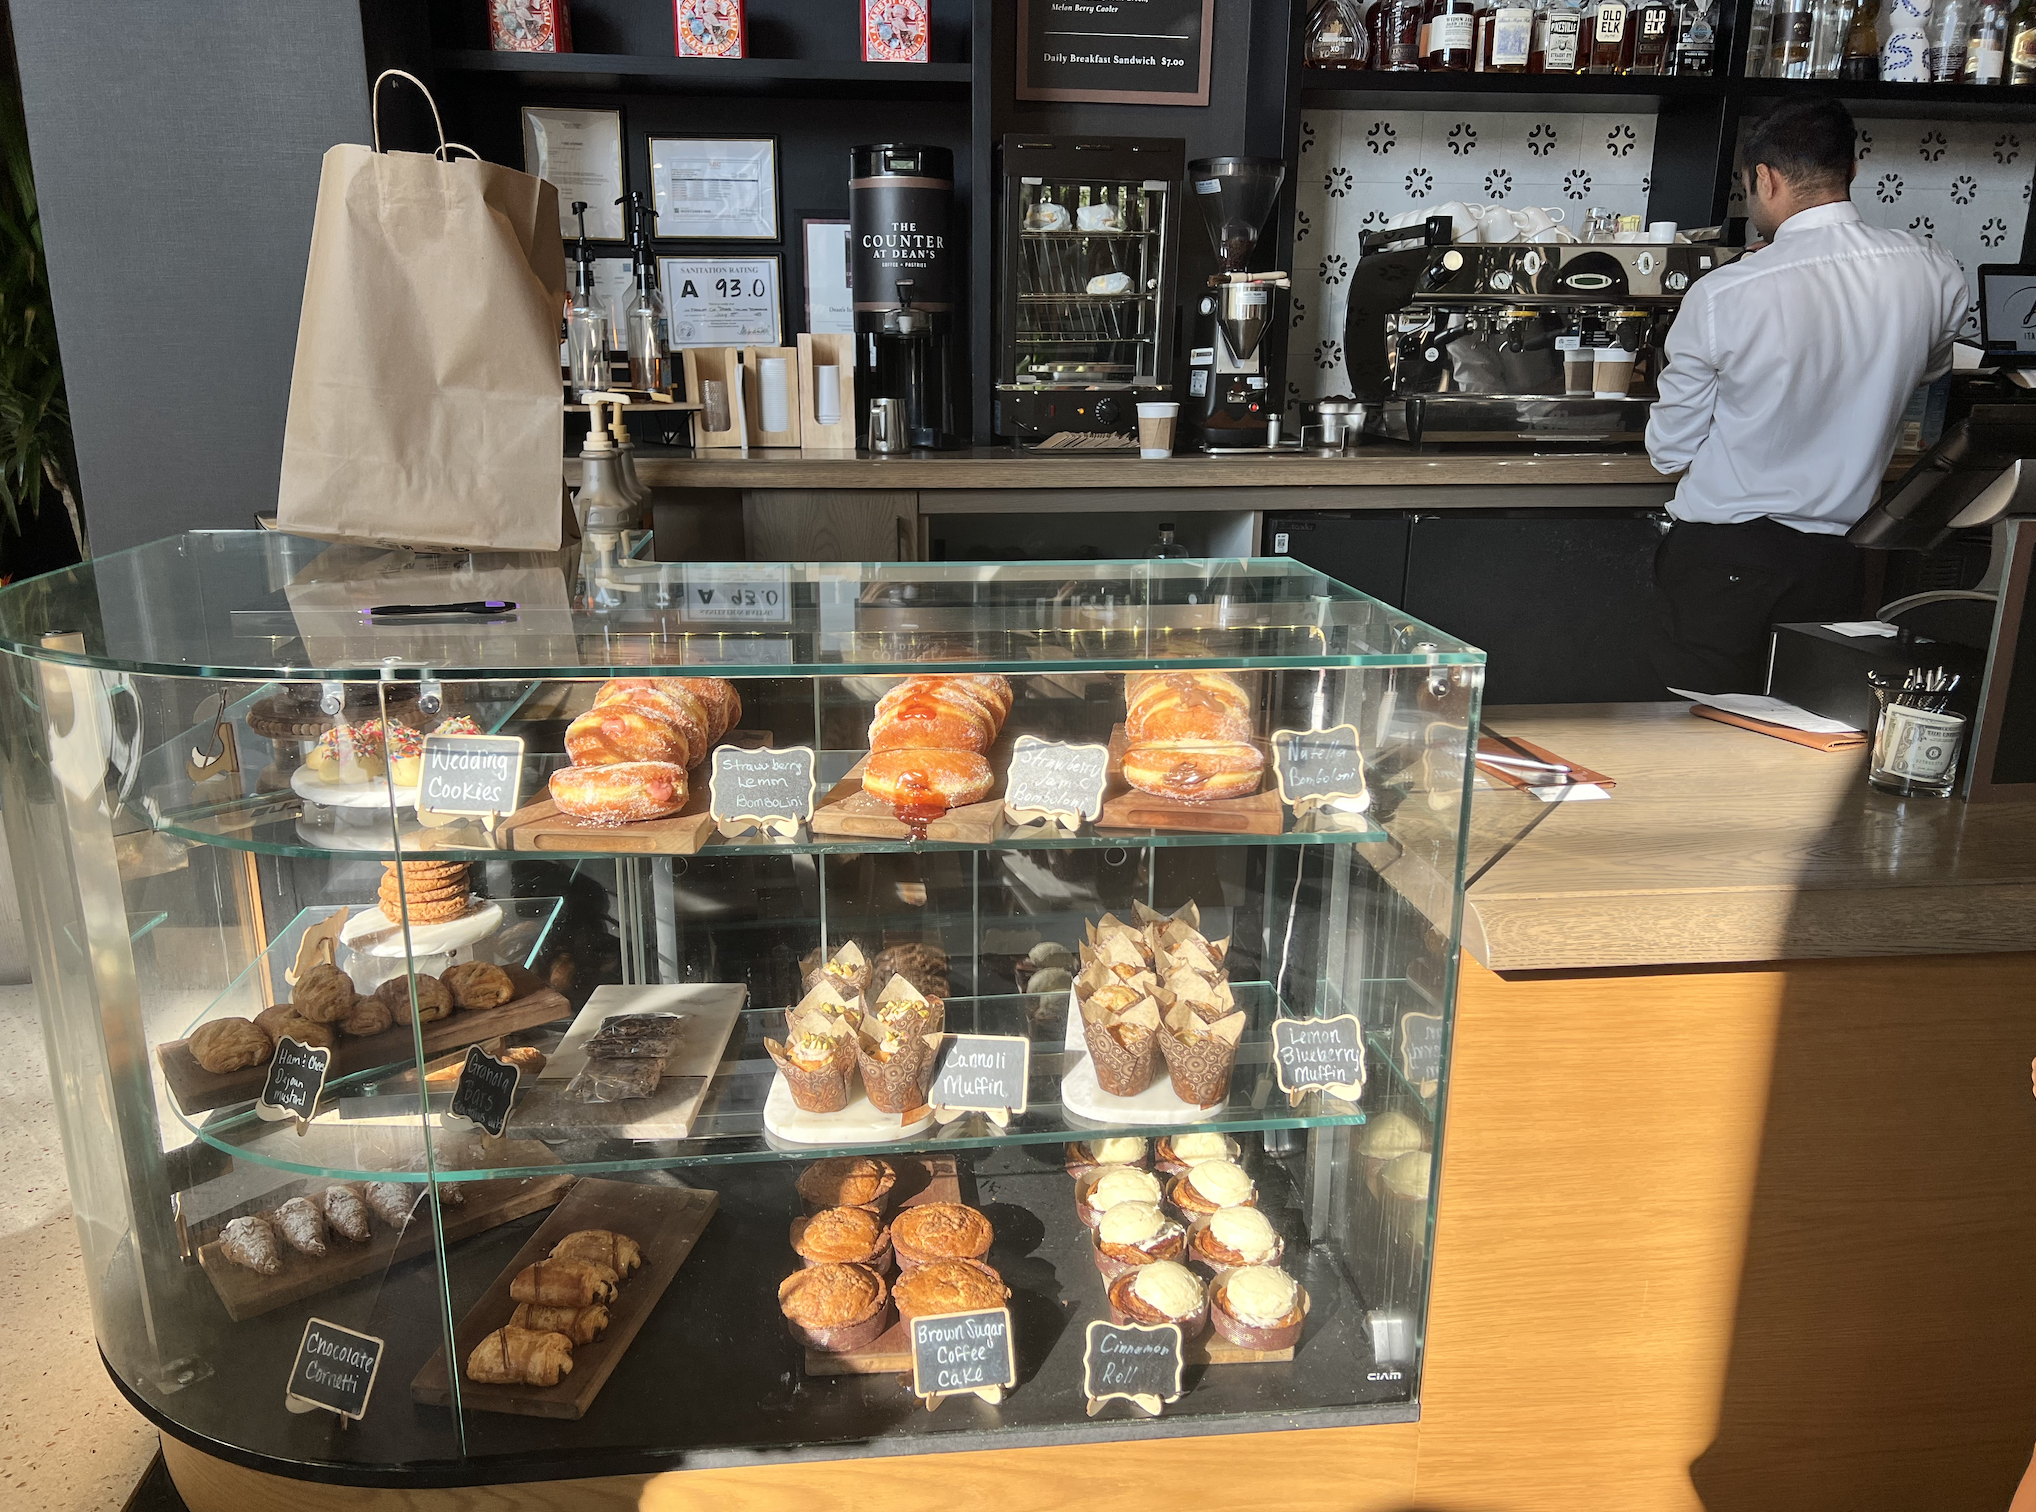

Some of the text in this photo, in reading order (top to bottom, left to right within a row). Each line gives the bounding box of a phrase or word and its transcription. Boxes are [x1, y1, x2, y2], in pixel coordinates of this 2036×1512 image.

[1051, 4, 1119, 14] Melon Berry Cooler
[1603, 10, 1621, 20] OLD
[1646, 10, 1666, 22] OLD
[1601, 22, 1620, 33] ELK
[1644, 22, 1665, 34] ELK
[499, 29, 547, 48] LAZZARONI
[686, 35, 733, 54] LAZZARONI
[874, 40, 921, 58] LAZZARONI
[1043, 53, 1185, 67] Daily Breakfast Sandwich $7.00
[891, 222, 917, 232] THE
[862, 234, 945, 249] COUNTER
[873, 249, 936, 259] AT DEAN'S
[680, 266, 759, 274] SANITATION RATING
[681, 279, 699, 298] A
[1288, 736, 1348, 761] Nutella
[431, 743, 508, 781] Wedding
[722, 758, 803, 776] Strawberry
[1021, 742, 1101, 777] Strawberry
[1289, 766, 1356, 787] Bomboloni
[428, 776, 502, 802] Cookies
[1289, 1027, 1342, 1045] Lemon
[278, 1048, 301, 1065] Ham
[945, 1045, 1006, 1069] Cannoli
[1280, 1046, 1360, 1072] Blueberry
[468, 1053, 509, 1093] Granola
[1294, 1064, 1346, 1083] Muffin
[464, 1080, 493, 1111] Bars
[943, 1075, 1005, 1098] Muffin
[918, 1319, 1005, 1349] Brown Sugar
[1100, 1332, 1170, 1355] Cinnamon
[306, 1331, 374, 1373] Chocolate
[937, 1344, 987, 1364] Coffee
[305, 1360, 360, 1394] Cornetti
[937, 1367, 984, 1387] Cake
[1102, 1361, 1139, 1385] Roll
